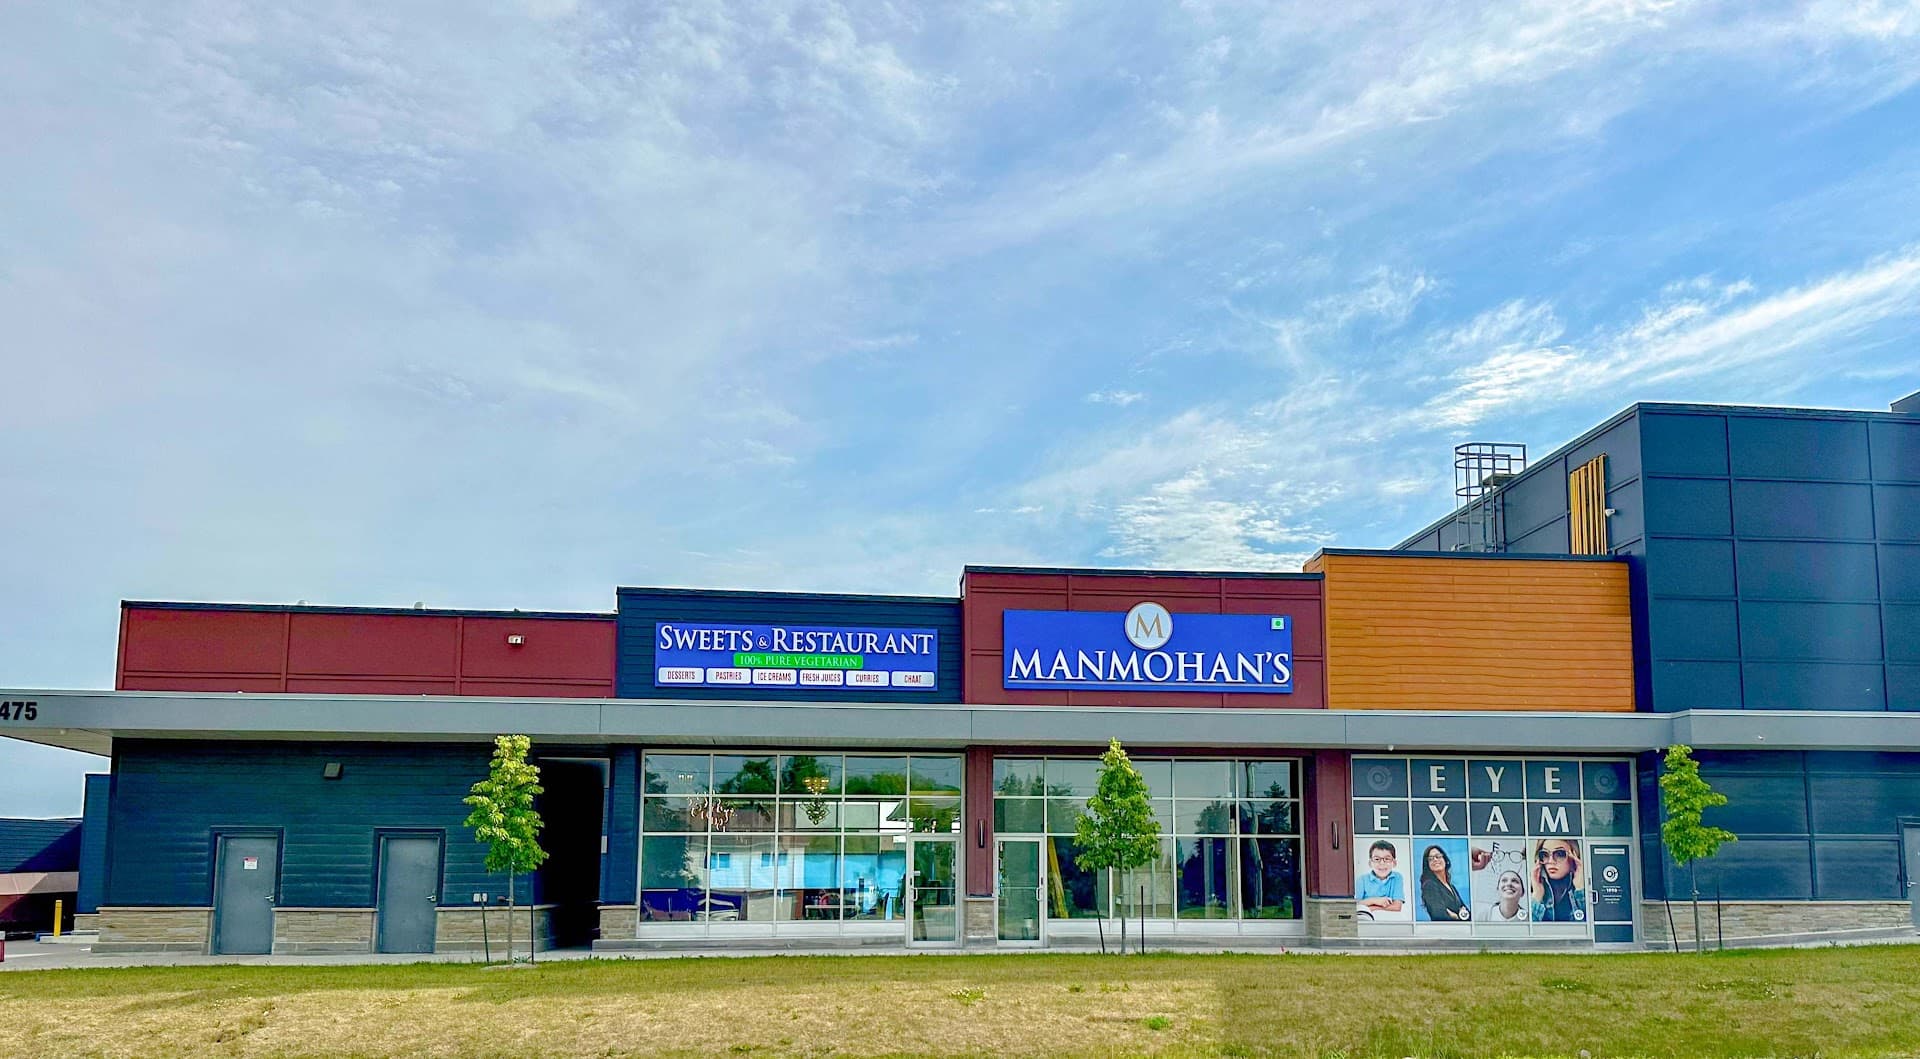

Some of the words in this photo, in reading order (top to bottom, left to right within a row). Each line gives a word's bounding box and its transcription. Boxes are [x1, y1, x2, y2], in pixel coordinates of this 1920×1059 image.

[1135, 612, 1164, 638] M
[660, 625, 753, 652] SWEETS
[758, 636, 769, 648] &
[772, 628, 933, 654] RESTAURANT
[740, 655, 763, 666] 100%
[765, 656, 792, 666] PURE
[794, 657, 858, 667] VEGETARIAN
[1008, 648, 1291, 684] MANMOHAN'S
[667, 671, 696, 681] DESSERTS
[715, 671, 742, 681] PASTRIES
[757, 672, 767, 681] ICE
[768, 672, 792, 682] CREAMS
[802, 673, 820, 682] FRESH
[821, 673, 841, 682] JUICES
[855, 674, 880, 683] CURRIES
[904, 675, 922, 684] CHAAT
[0, 701, 38, 721] 475
[1429, 765, 1561, 794] EYE
[1373, 804, 1570, 833] EXAM
